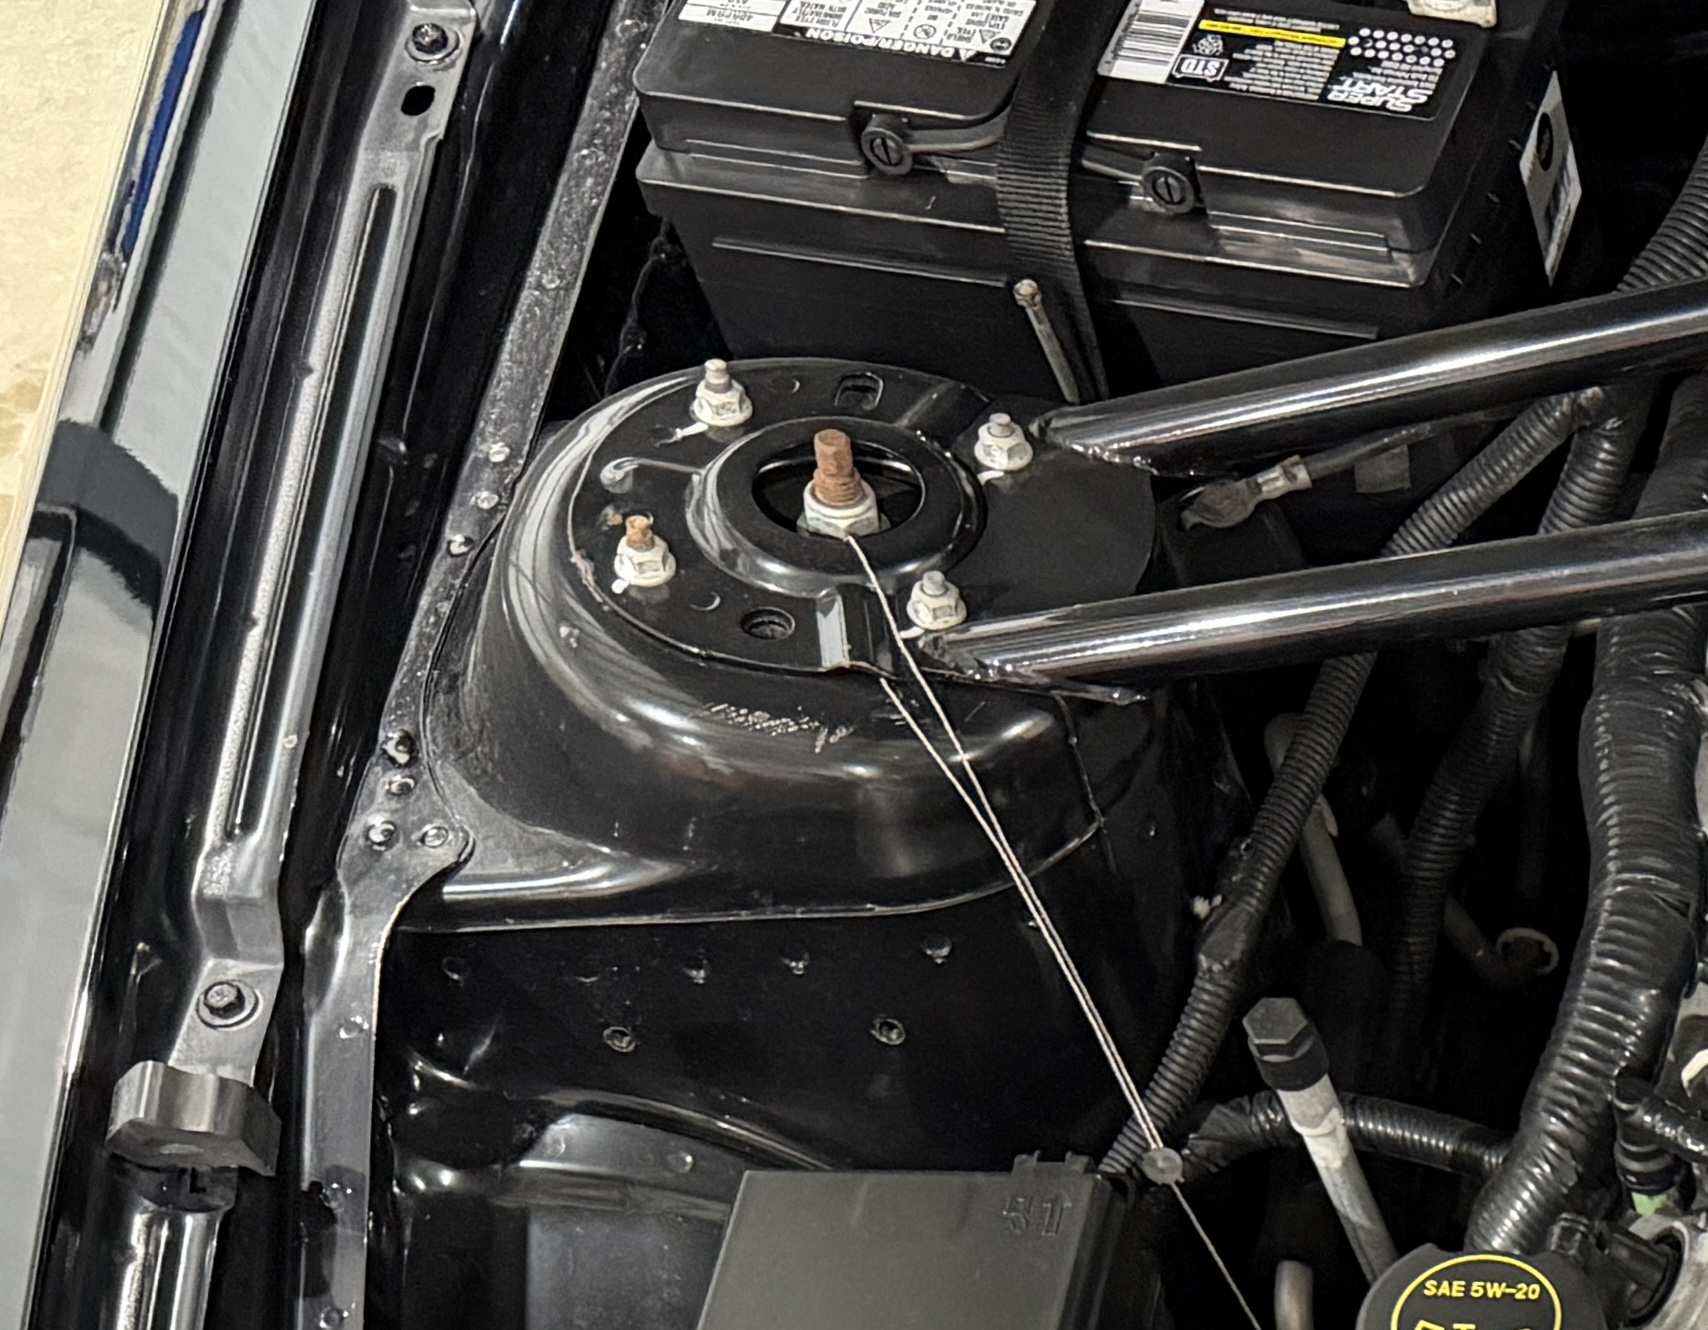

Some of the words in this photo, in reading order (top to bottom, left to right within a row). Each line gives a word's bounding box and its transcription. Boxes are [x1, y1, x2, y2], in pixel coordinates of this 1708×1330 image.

[805, 28, 956, 58] DANGER/POISON
[1180, 59, 1218, 77] STD
[1327, 89, 1412, 113] SUPER
[1334, 76, 1434, 104] START
[1423, 1280, 1465, 1297] SAE
[1470, 1281, 1540, 1299] 5W-20
